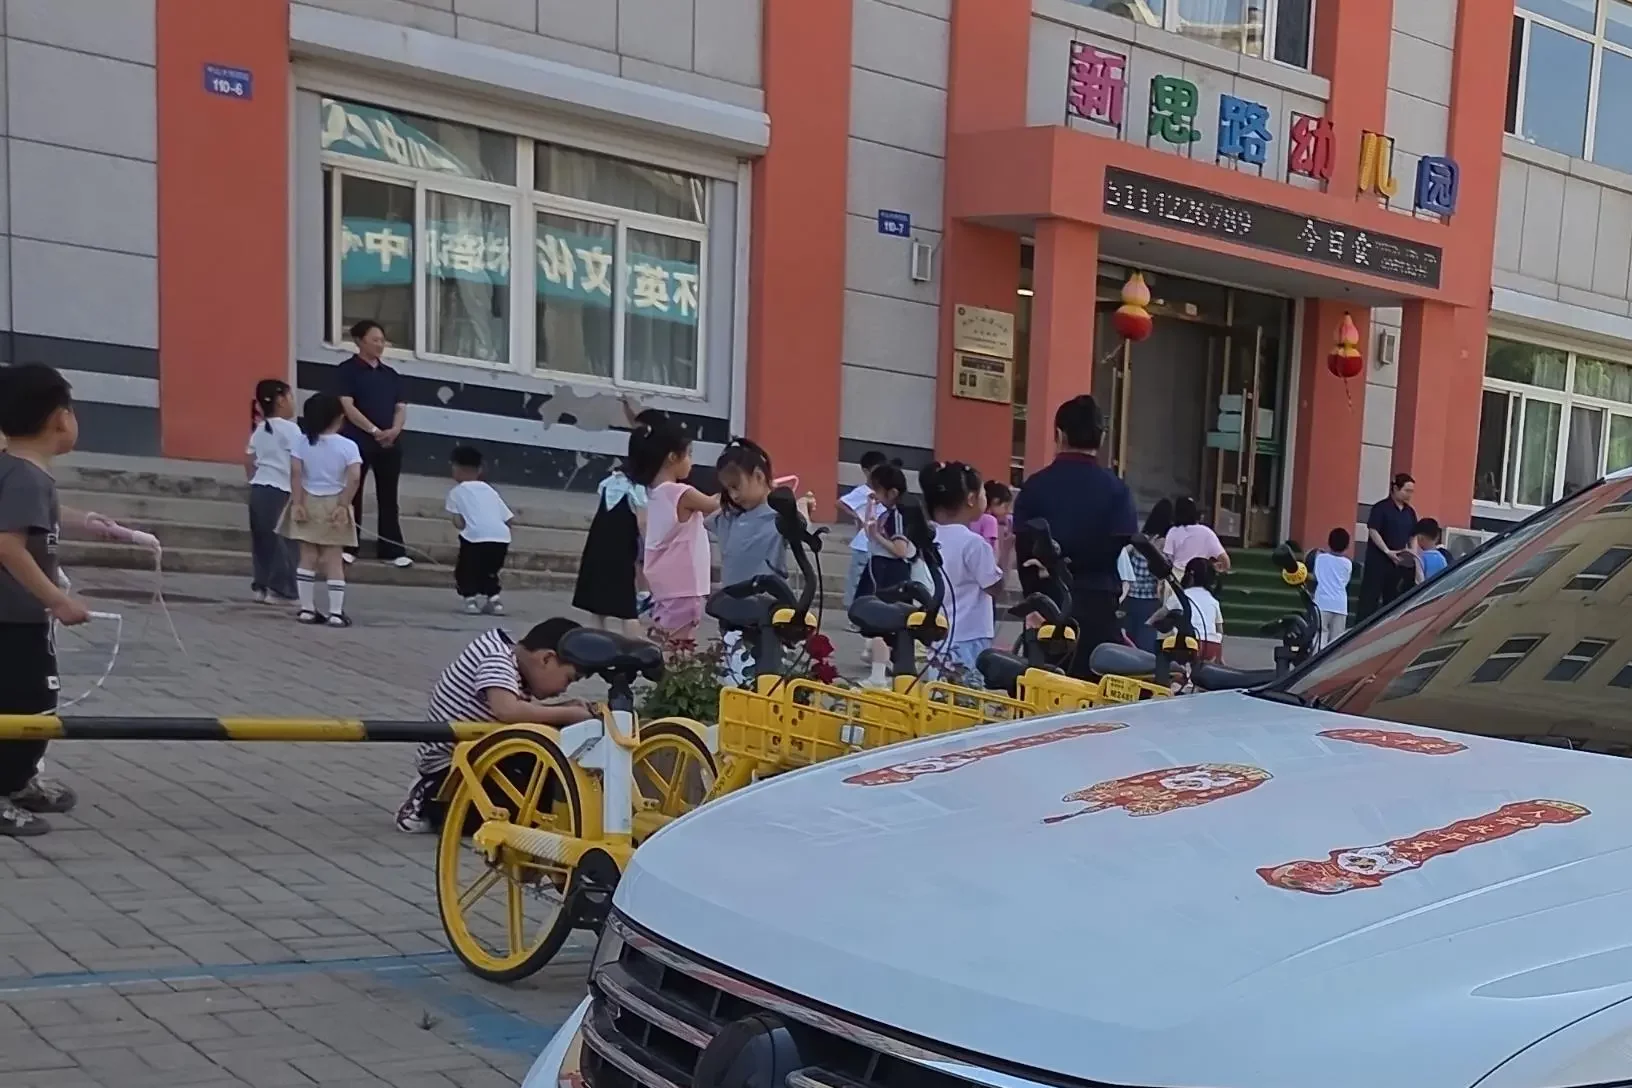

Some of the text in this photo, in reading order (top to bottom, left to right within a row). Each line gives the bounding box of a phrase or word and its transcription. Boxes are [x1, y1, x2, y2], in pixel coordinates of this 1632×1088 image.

[1070, 43, 1460, 216] 新思路幼儿园
